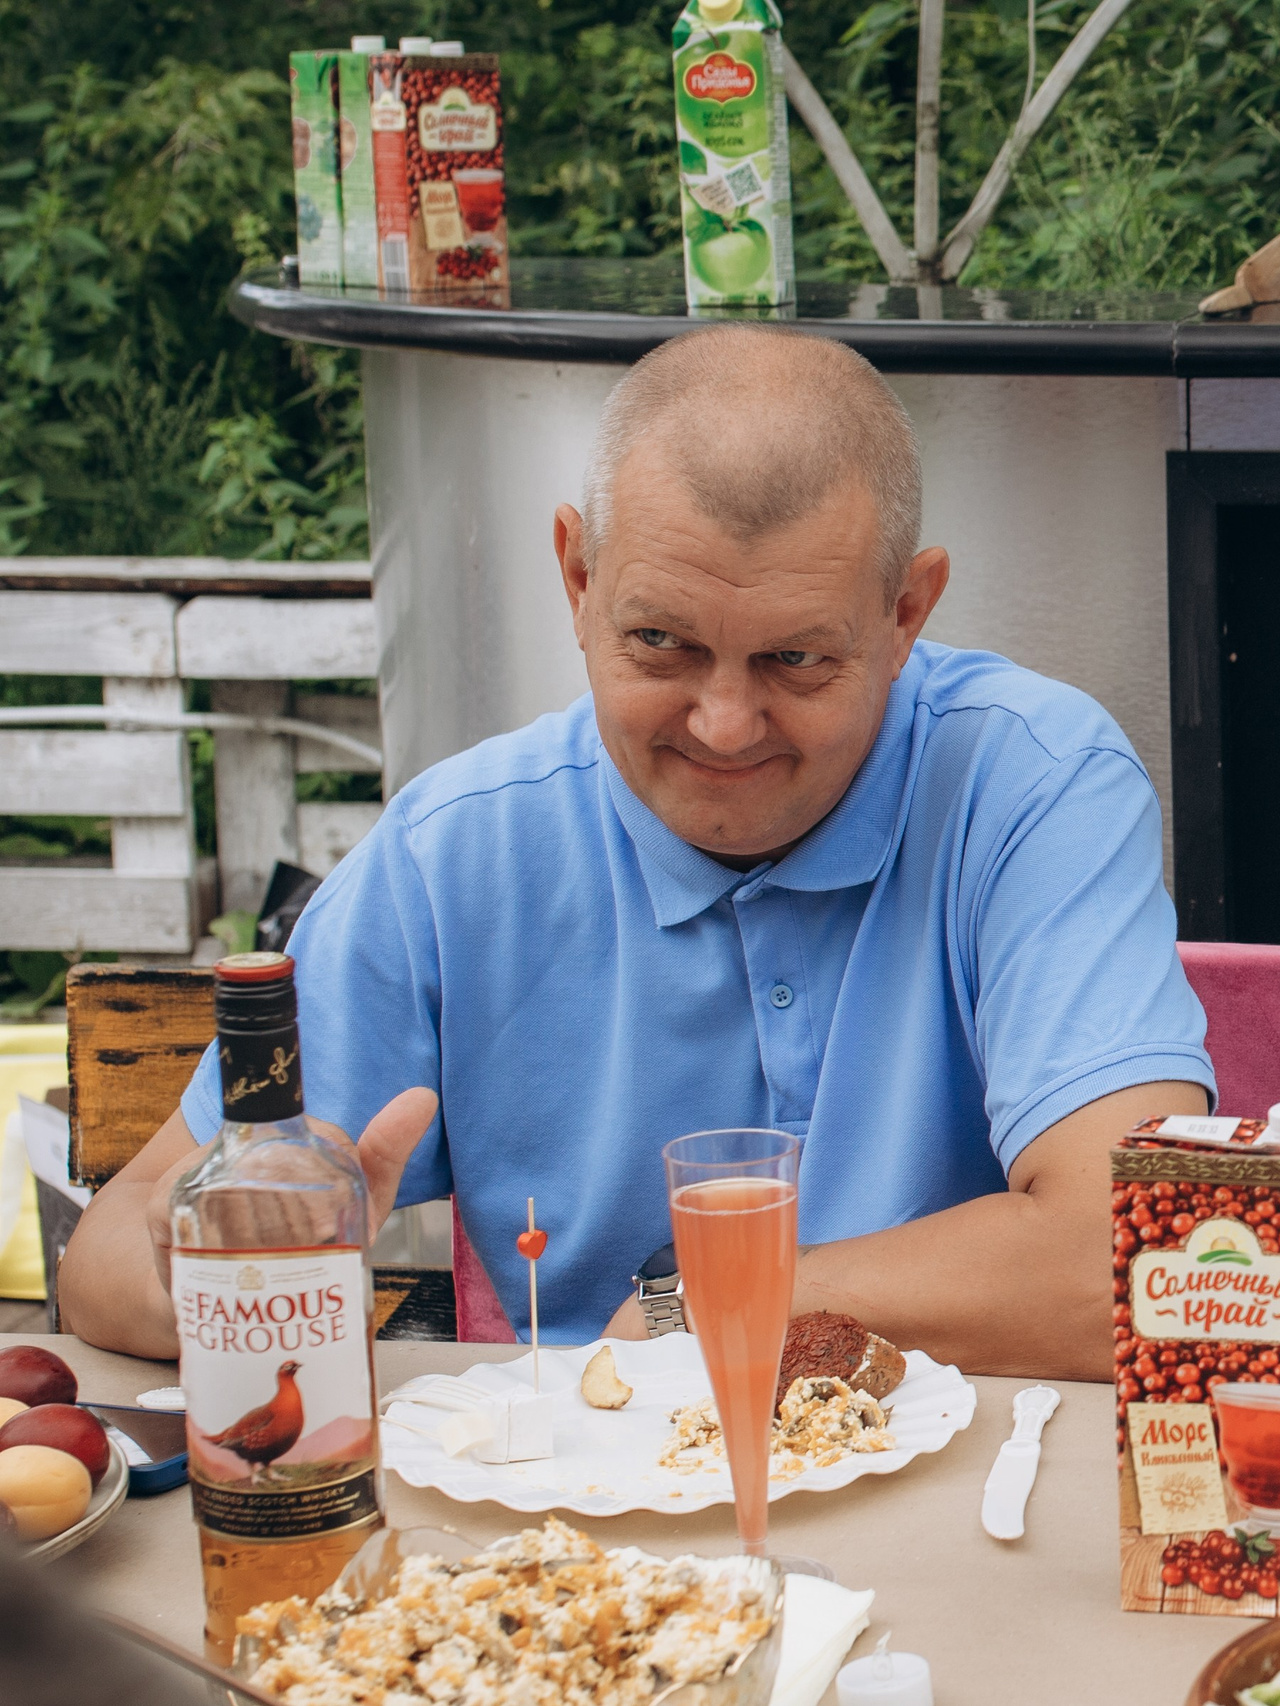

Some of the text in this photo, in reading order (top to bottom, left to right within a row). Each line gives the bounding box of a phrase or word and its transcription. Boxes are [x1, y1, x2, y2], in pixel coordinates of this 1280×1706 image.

[181, 1286, 197, 1342] THE
[196, 1284, 344, 1324] FAMOUS
[1183, 1297, 1268, 1333] край
[196, 1314, 347, 1354] GROUSE
[1141, 1419, 1208, 1450] Морс
[247, 1495, 298, 1508] SCOTCH
